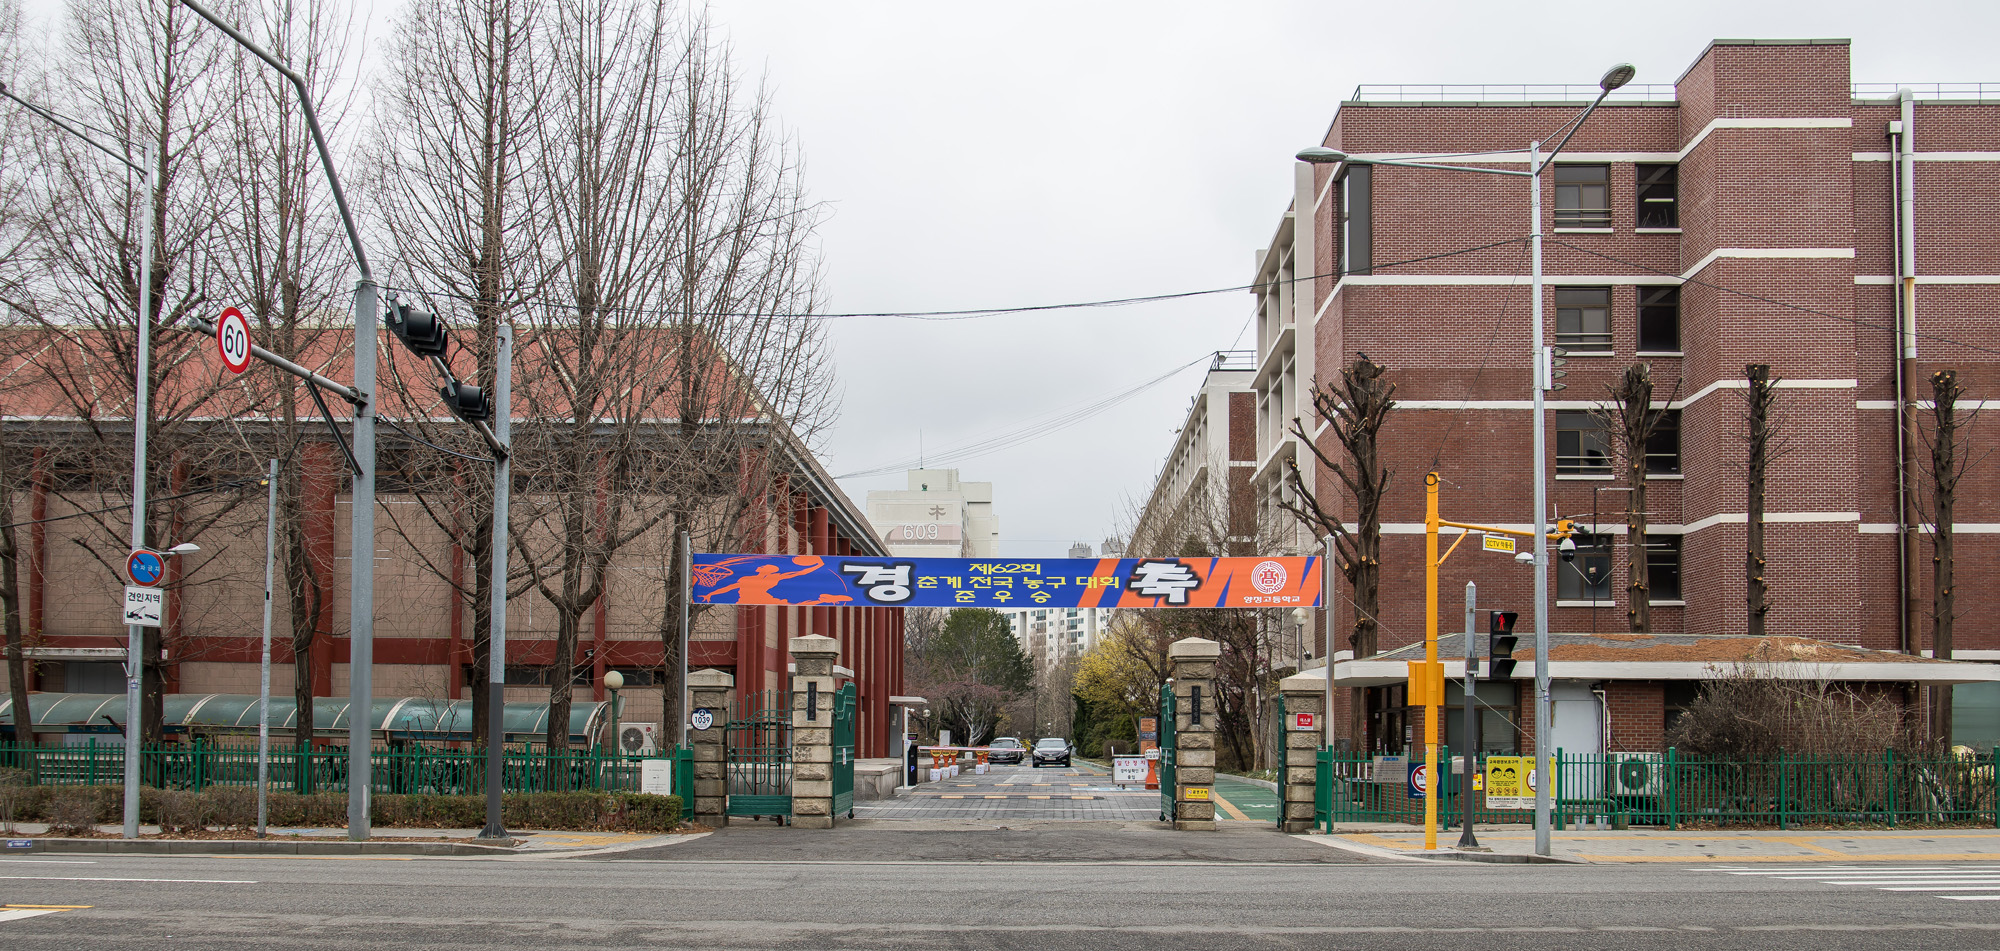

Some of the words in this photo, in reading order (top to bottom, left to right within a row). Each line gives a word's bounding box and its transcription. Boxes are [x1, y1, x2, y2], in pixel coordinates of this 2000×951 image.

[225, 324, 244, 358] 60
[903, 523, 938, 540] 609
[968, 563, 1041, 575] 제62회
[843, 564, 911, 602] 경
[917, 576, 962, 589] 춘계
[969, 576, 1014, 589] 전국
[1023, 576, 1067, 589] 농구
[1076, 577, 1120, 589] 대회
[1130, 562, 1199, 603] 축
[128, 592, 160, 603] 견인지역
[694, 716, 711, 724] 1039
[910, 765, 915, 773] P
